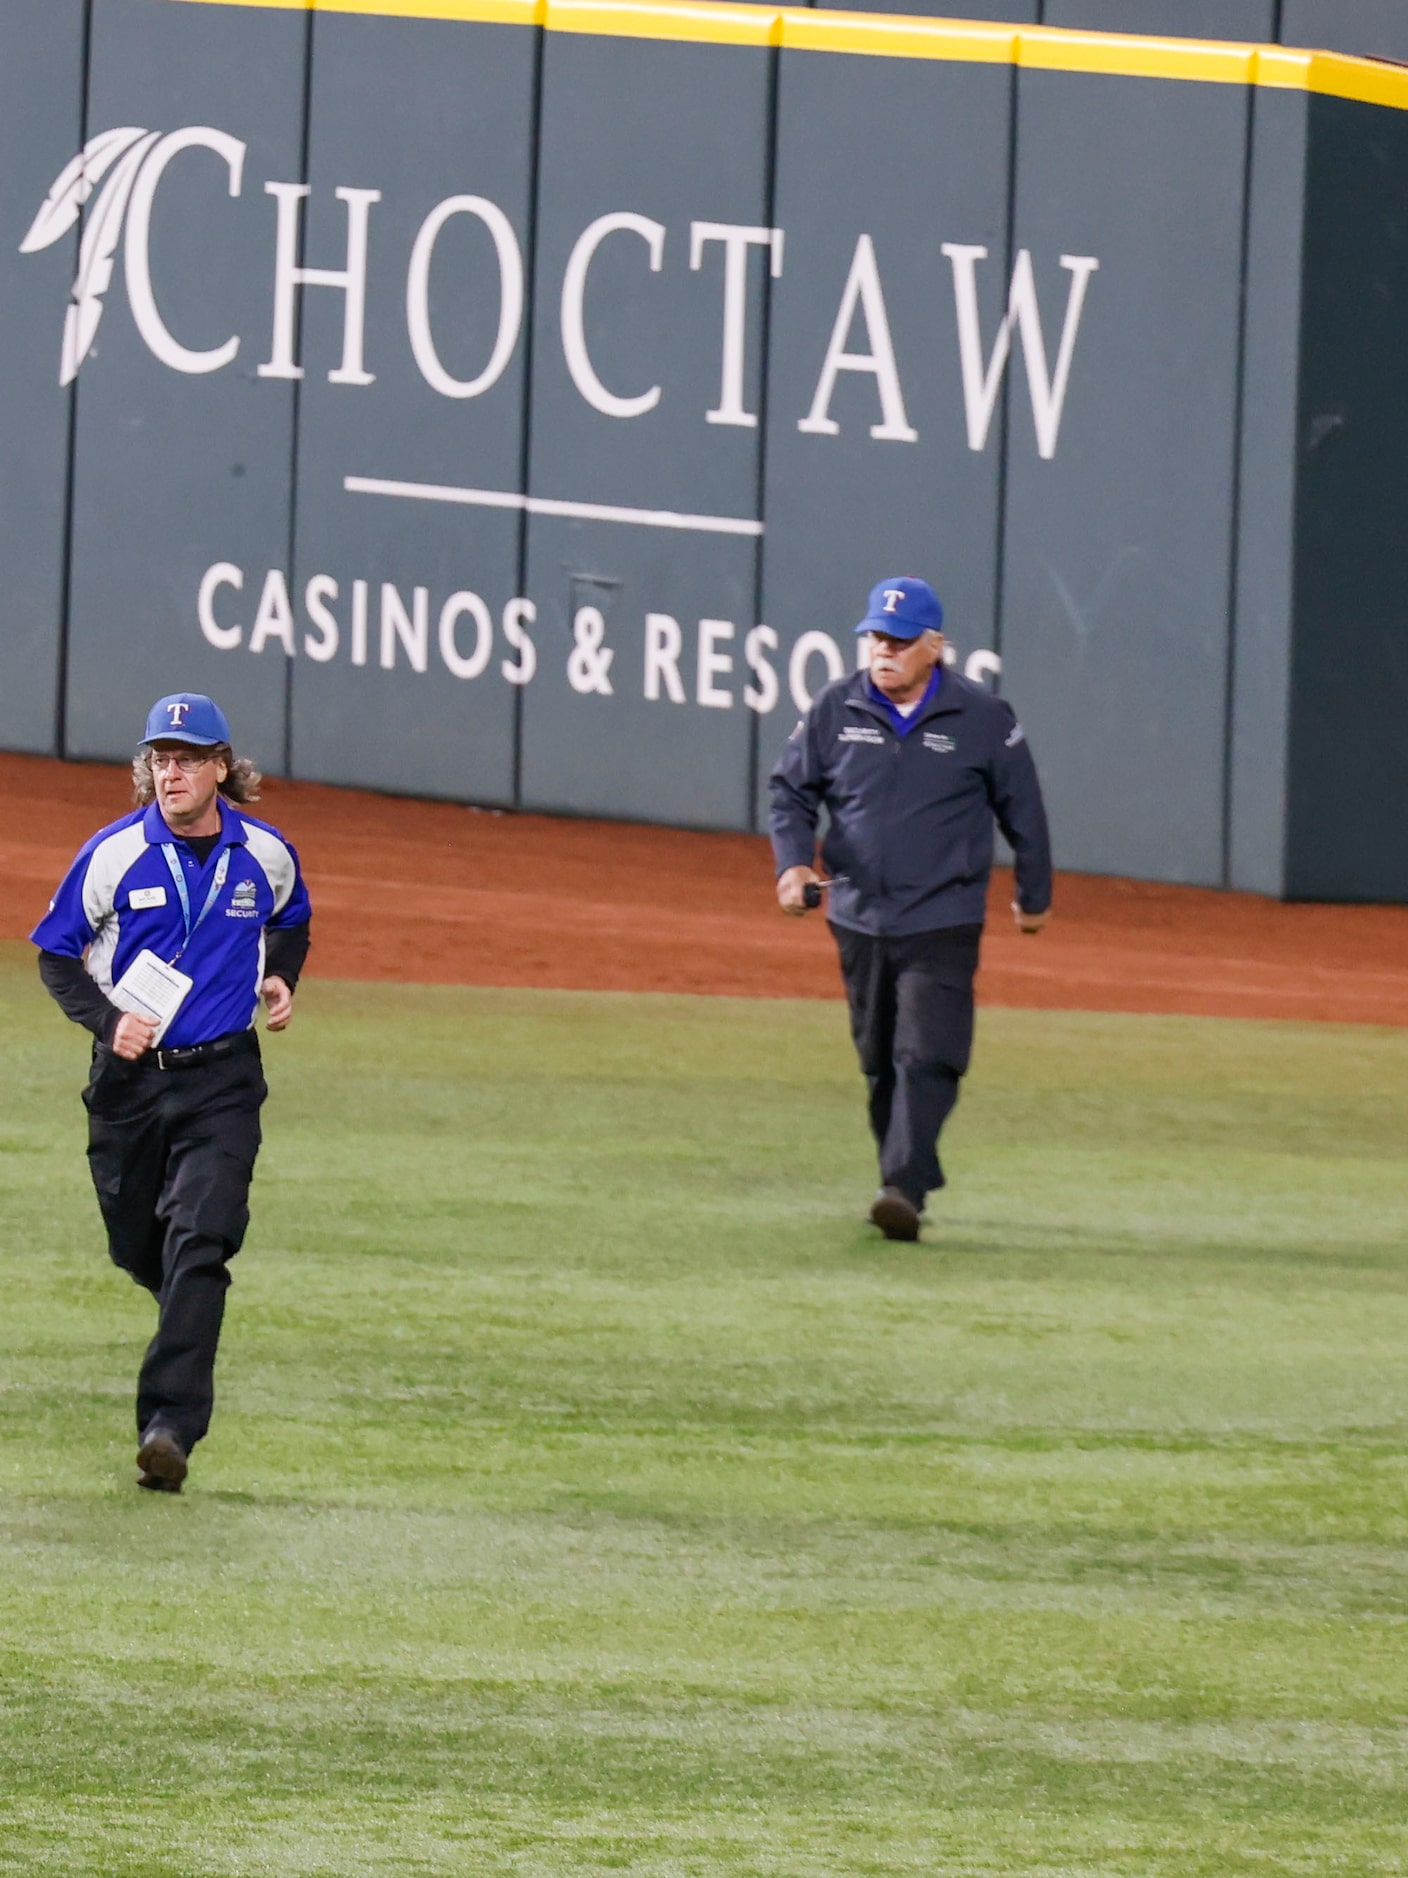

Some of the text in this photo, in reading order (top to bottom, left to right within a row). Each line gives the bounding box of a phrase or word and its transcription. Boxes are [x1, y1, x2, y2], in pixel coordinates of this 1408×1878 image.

[123, 126, 1099, 459] CHOCTAW
[196, 562, 1000, 716] CASINOS & RESO
[882, 589, 905, 612] T
[166, 703, 190, 726] T
